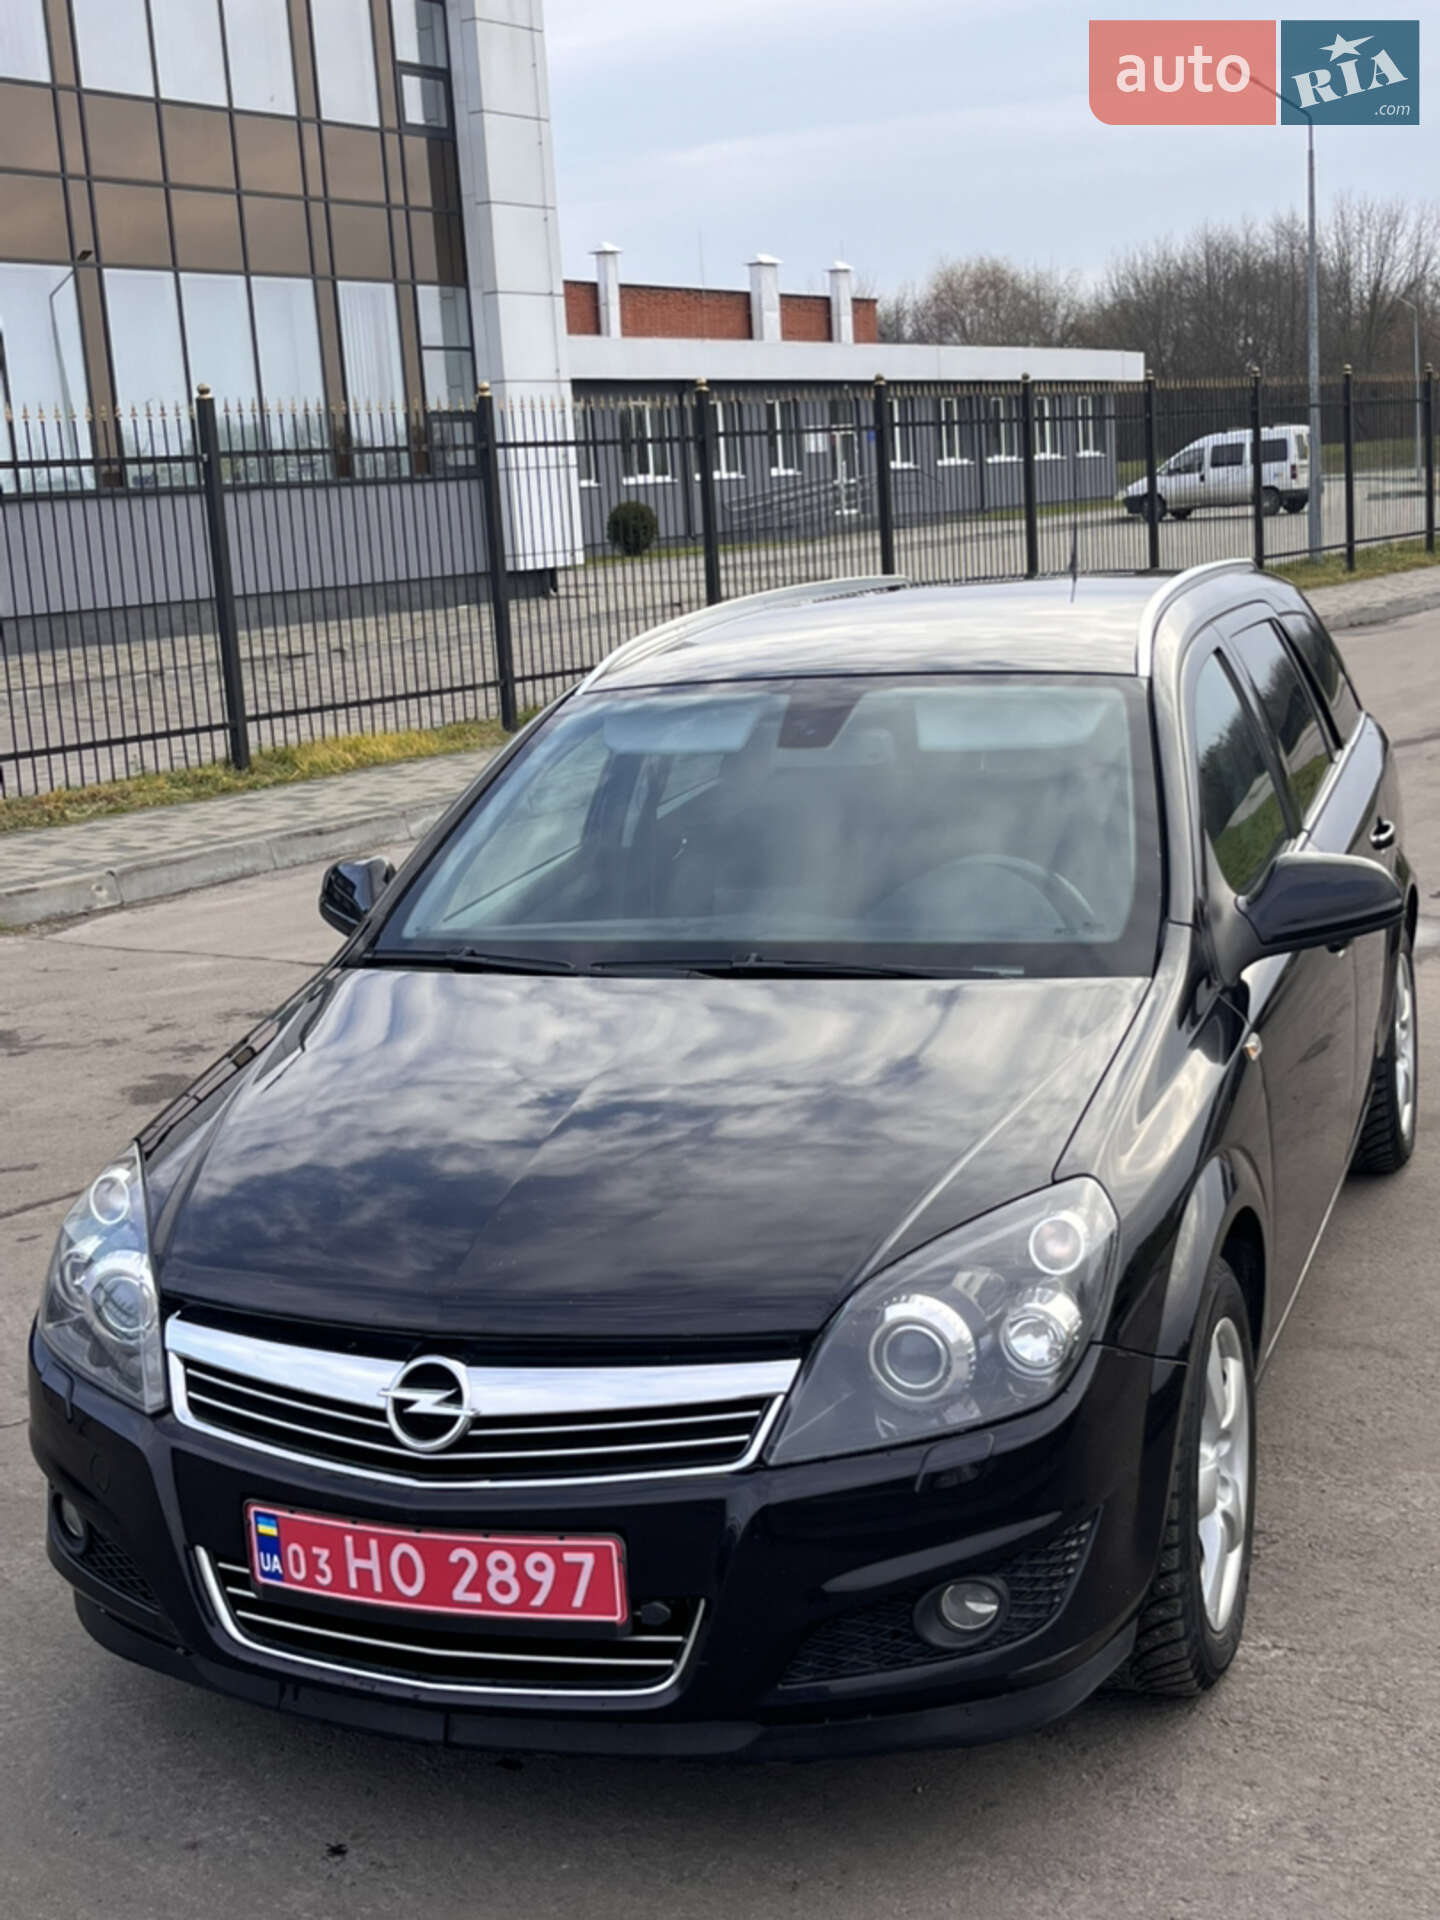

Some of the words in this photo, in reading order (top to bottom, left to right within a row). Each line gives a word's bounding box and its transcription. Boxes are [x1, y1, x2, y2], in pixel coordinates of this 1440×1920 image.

[259, 1551, 283, 1575] UA
[286, 1542, 333, 1586] 03
[448, 1548, 596, 1608] 2897
